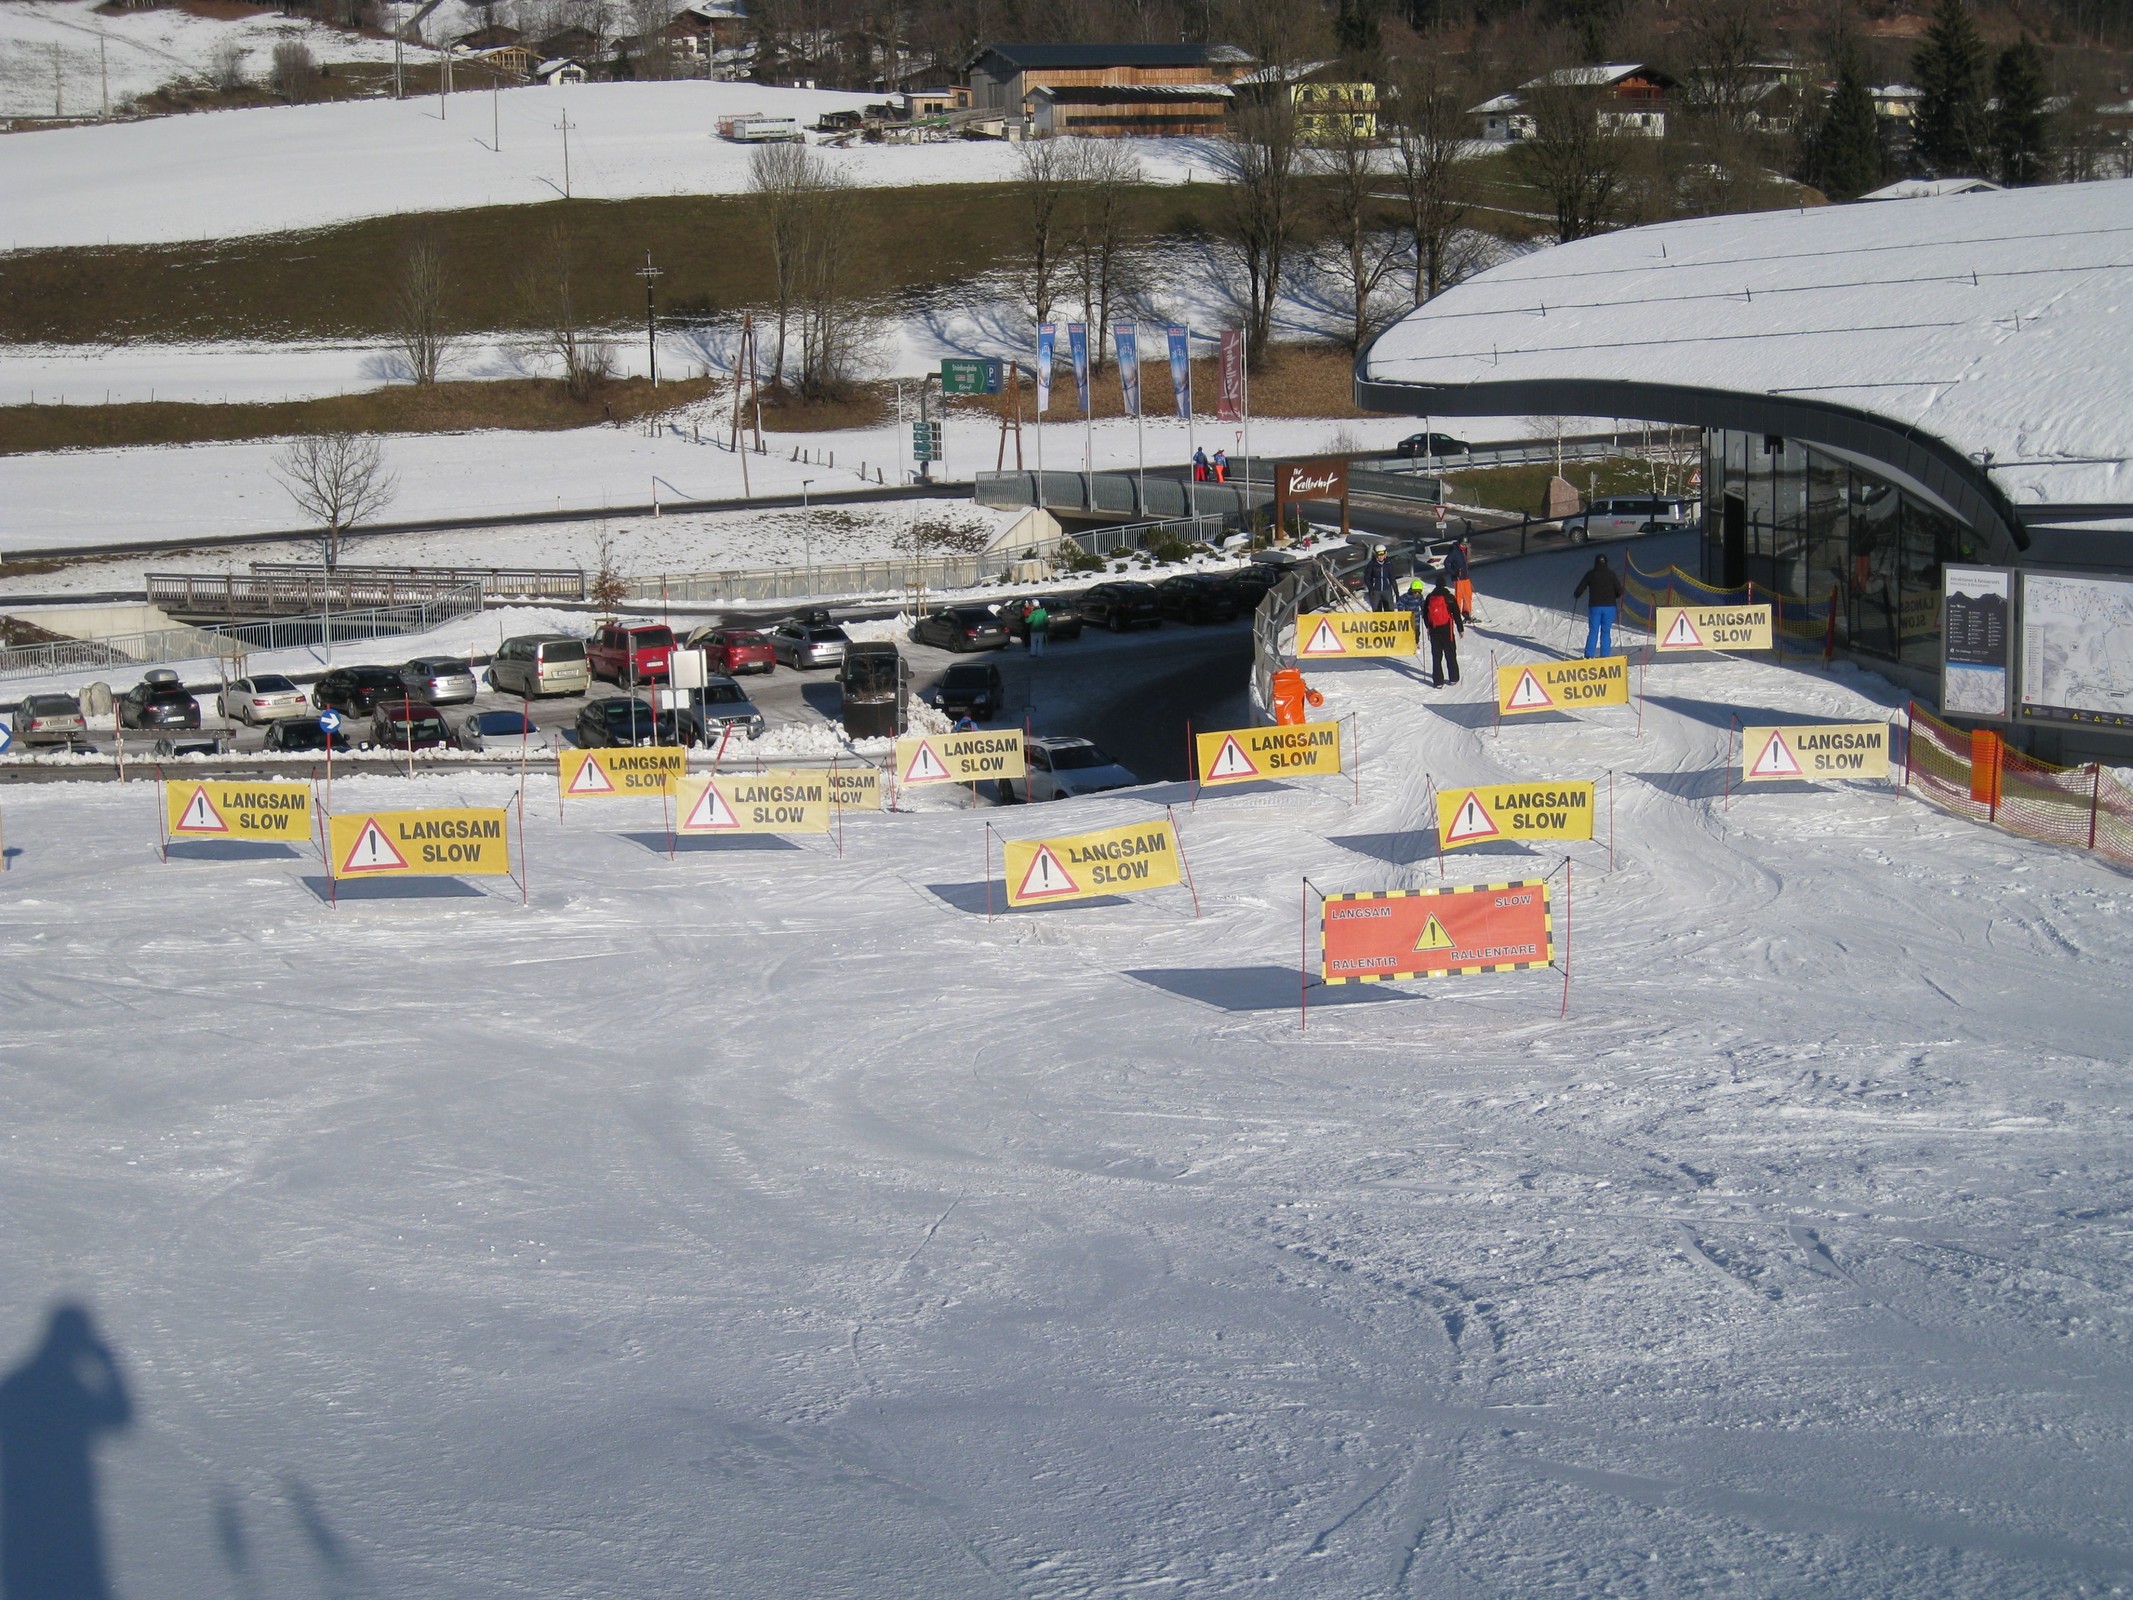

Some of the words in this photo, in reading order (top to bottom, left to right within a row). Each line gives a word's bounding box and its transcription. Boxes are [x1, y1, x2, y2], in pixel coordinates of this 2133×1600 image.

[1341, 619, 1410, 634] LANGSAM
[1699, 612, 1766, 627] LANGSAM
[1356, 636, 1396, 649] SLOW
[1712, 629, 1752, 643] SLOW
[1546, 664, 1622, 684] LANGSAM
[1563, 683, 1607, 700] SLOW
[944, 738, 1018, 757] LANGSAM
[1251, 730, 1334, 752] LANGSAM
[1797, 733, 1881, 750] LANGSAM
[609, 756, 681, 771] LANGSAM
[960, 756, 1004, 773] SLOW
[1269, 750, 1318, 769] SLOW
[1814, 753, 1864, 769] SLOW
[625, 773, 667, 788] SLOW
[222, 792, 305, 810] LANGSAM
[734, 785, 822, 803] LANGSAM
[1494, 791, 1586, 810] LANGSAM
[239, 813, 289, 830] SLOW
[752, 806, 805, 824] SLOW
[1512, 812, 1567, 830] SLOW
[399, 820, 501, 840] LANGSAM
[422, 843, 481, 863] SLOW
[1069, 832, 1167, 863] LANGSAM
[1092, 859, 1150, 884] SLOW
[1494, 894, 1532, 908] SLOW
[1331, 906, 1392, 920] LANGSAM
[1450, 943, 1536, 961] RALLENTARE
[1332, 956, 1398, 970] RALENTIR
